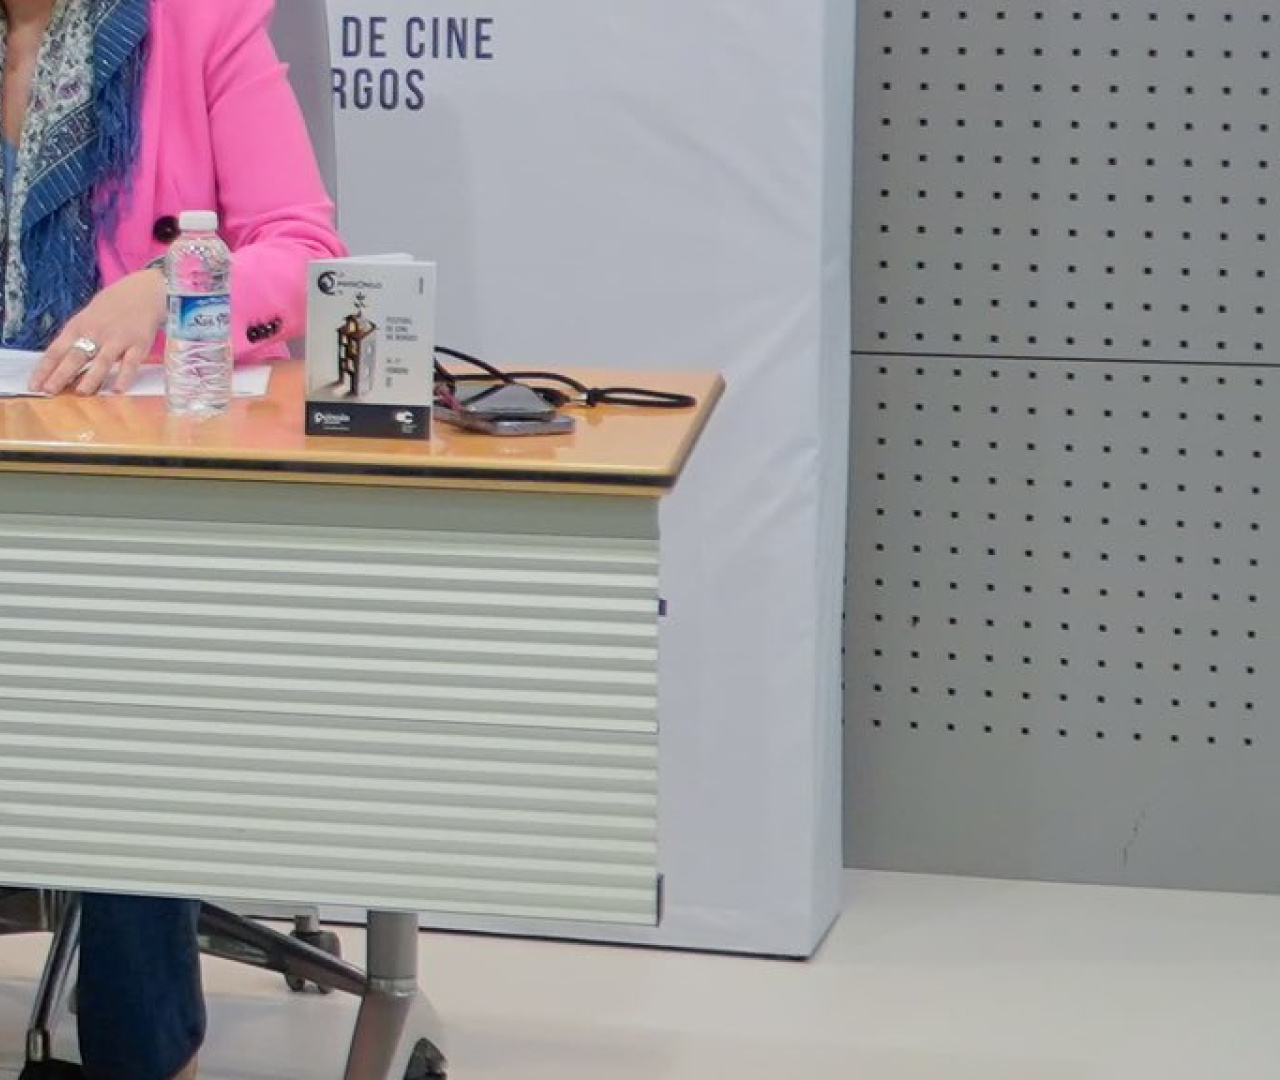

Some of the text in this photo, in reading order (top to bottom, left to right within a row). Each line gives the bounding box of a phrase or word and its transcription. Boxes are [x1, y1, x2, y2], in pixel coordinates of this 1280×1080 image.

[340, 15, 495, 60] DE CINE
[329, 67, 425, 111] RGOS
